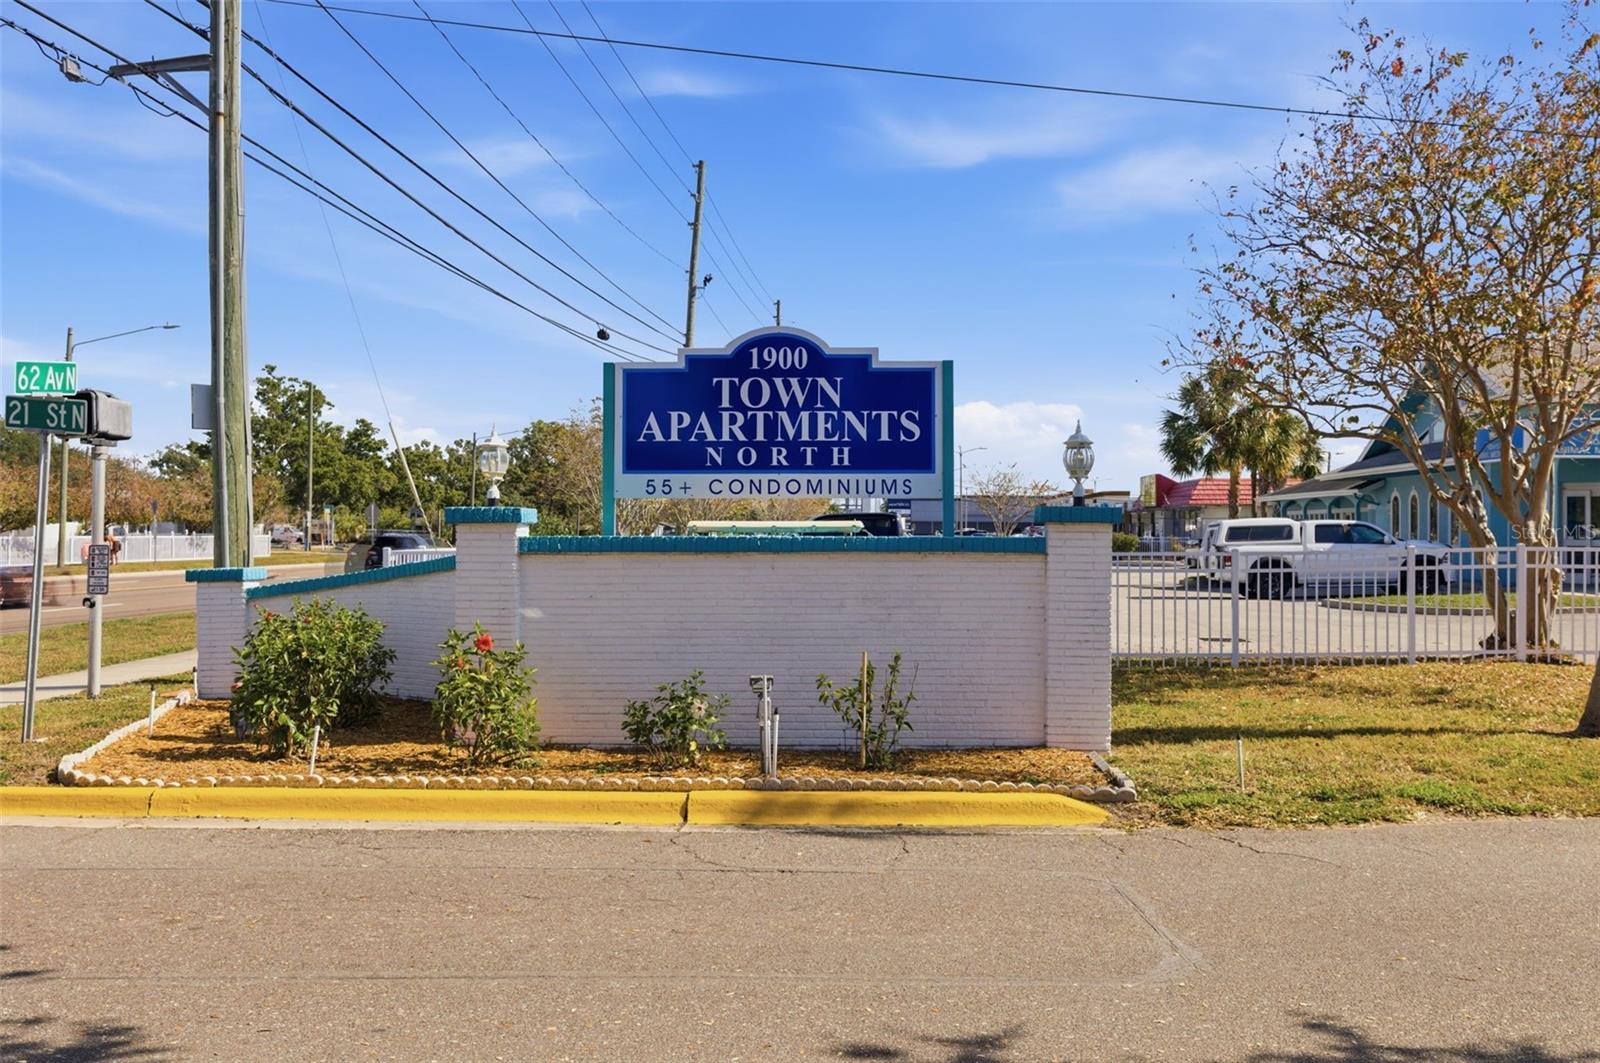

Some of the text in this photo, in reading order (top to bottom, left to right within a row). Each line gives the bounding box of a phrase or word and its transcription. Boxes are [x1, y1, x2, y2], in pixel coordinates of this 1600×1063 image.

[749, 347, 808, 370] 1900
[18, 365, 40, 390] 62
[712, 376, 843, 408] TOWN
[8, 400, 84, 430] 21 St N
[636, 410, 921, 443] APARTMENTS
[705, 446, 851, 467] NORTH
[645, 479, 912, 495] 55+ CONDOMINIUMS
